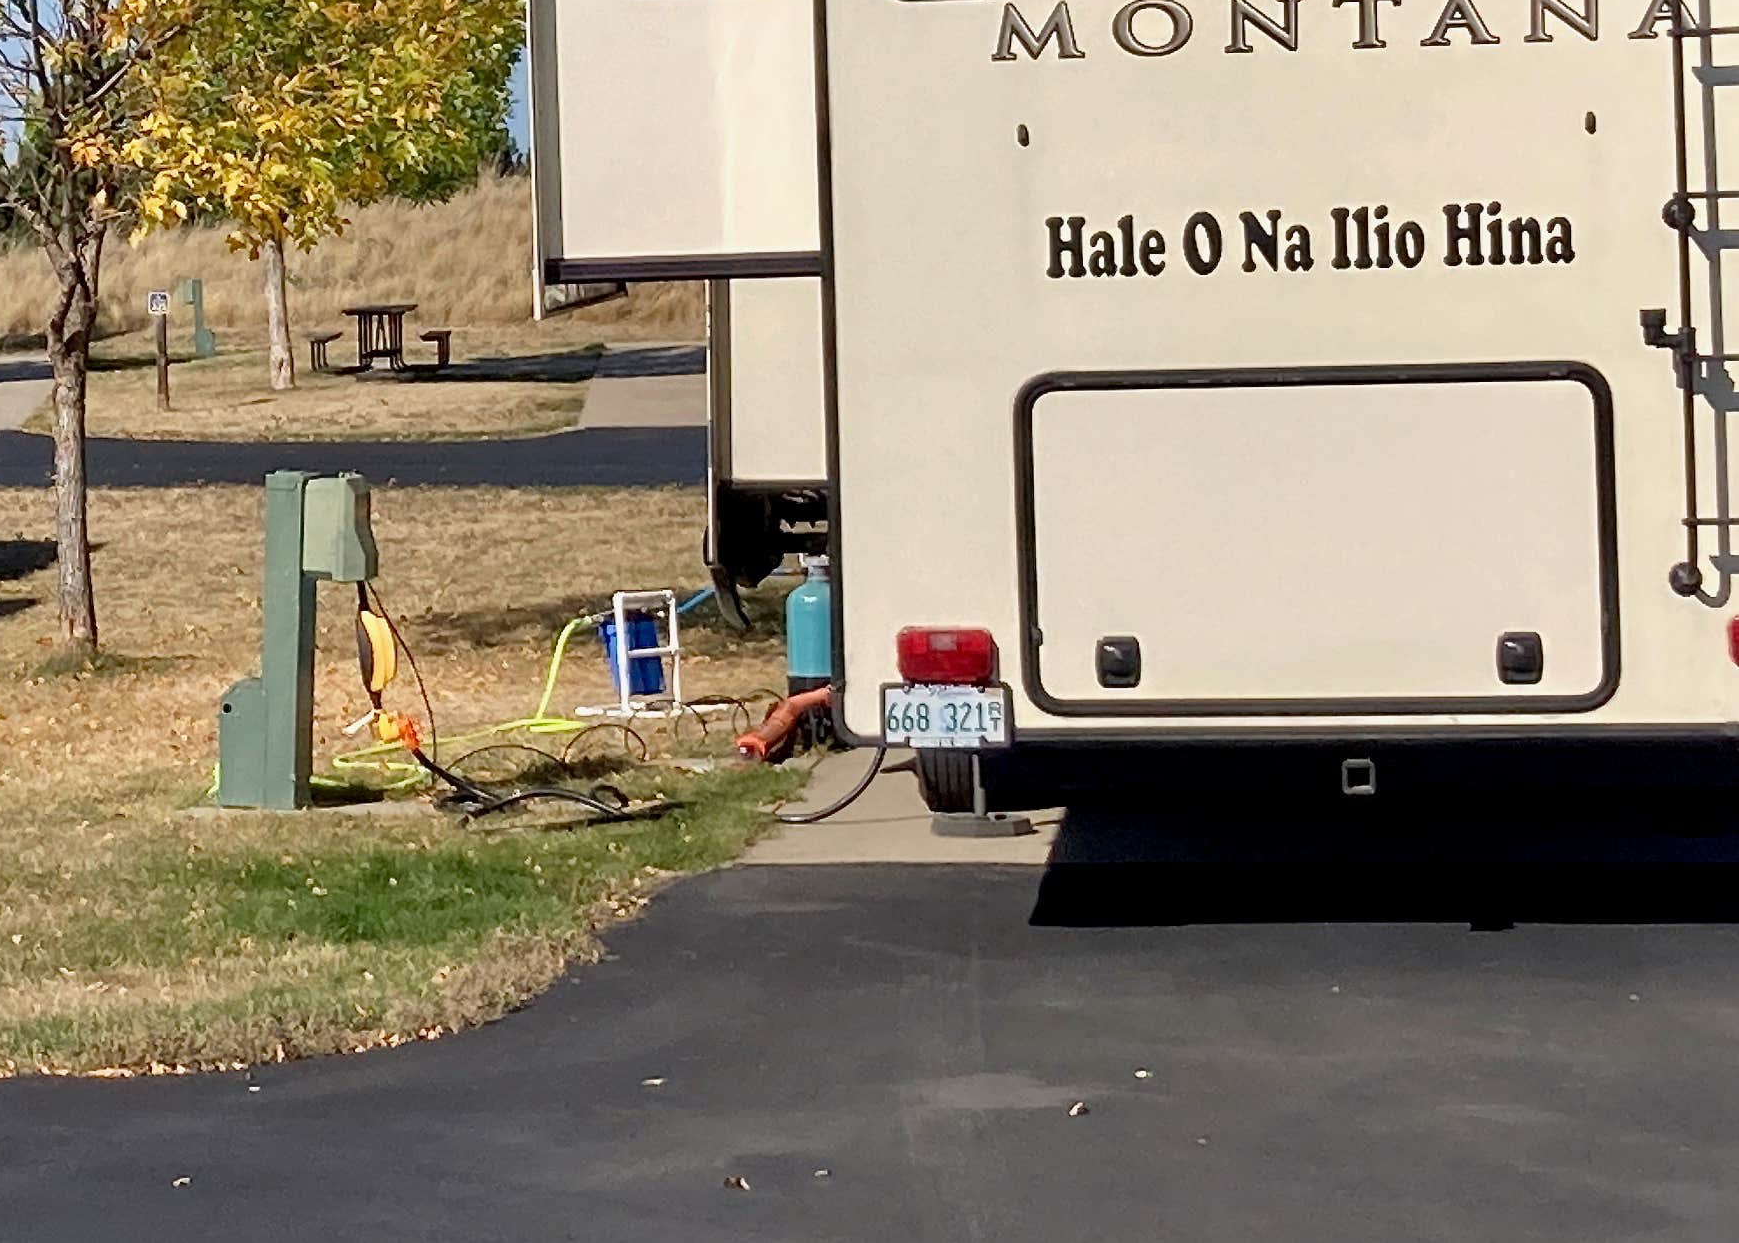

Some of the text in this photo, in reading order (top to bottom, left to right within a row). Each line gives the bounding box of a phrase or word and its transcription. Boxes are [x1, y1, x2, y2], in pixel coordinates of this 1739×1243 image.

[1044, 200, 1576, 279] Hale O Na Ilio Hina
[887, 701, 930, 733] 668
[943, 701, 988, 733] 321
